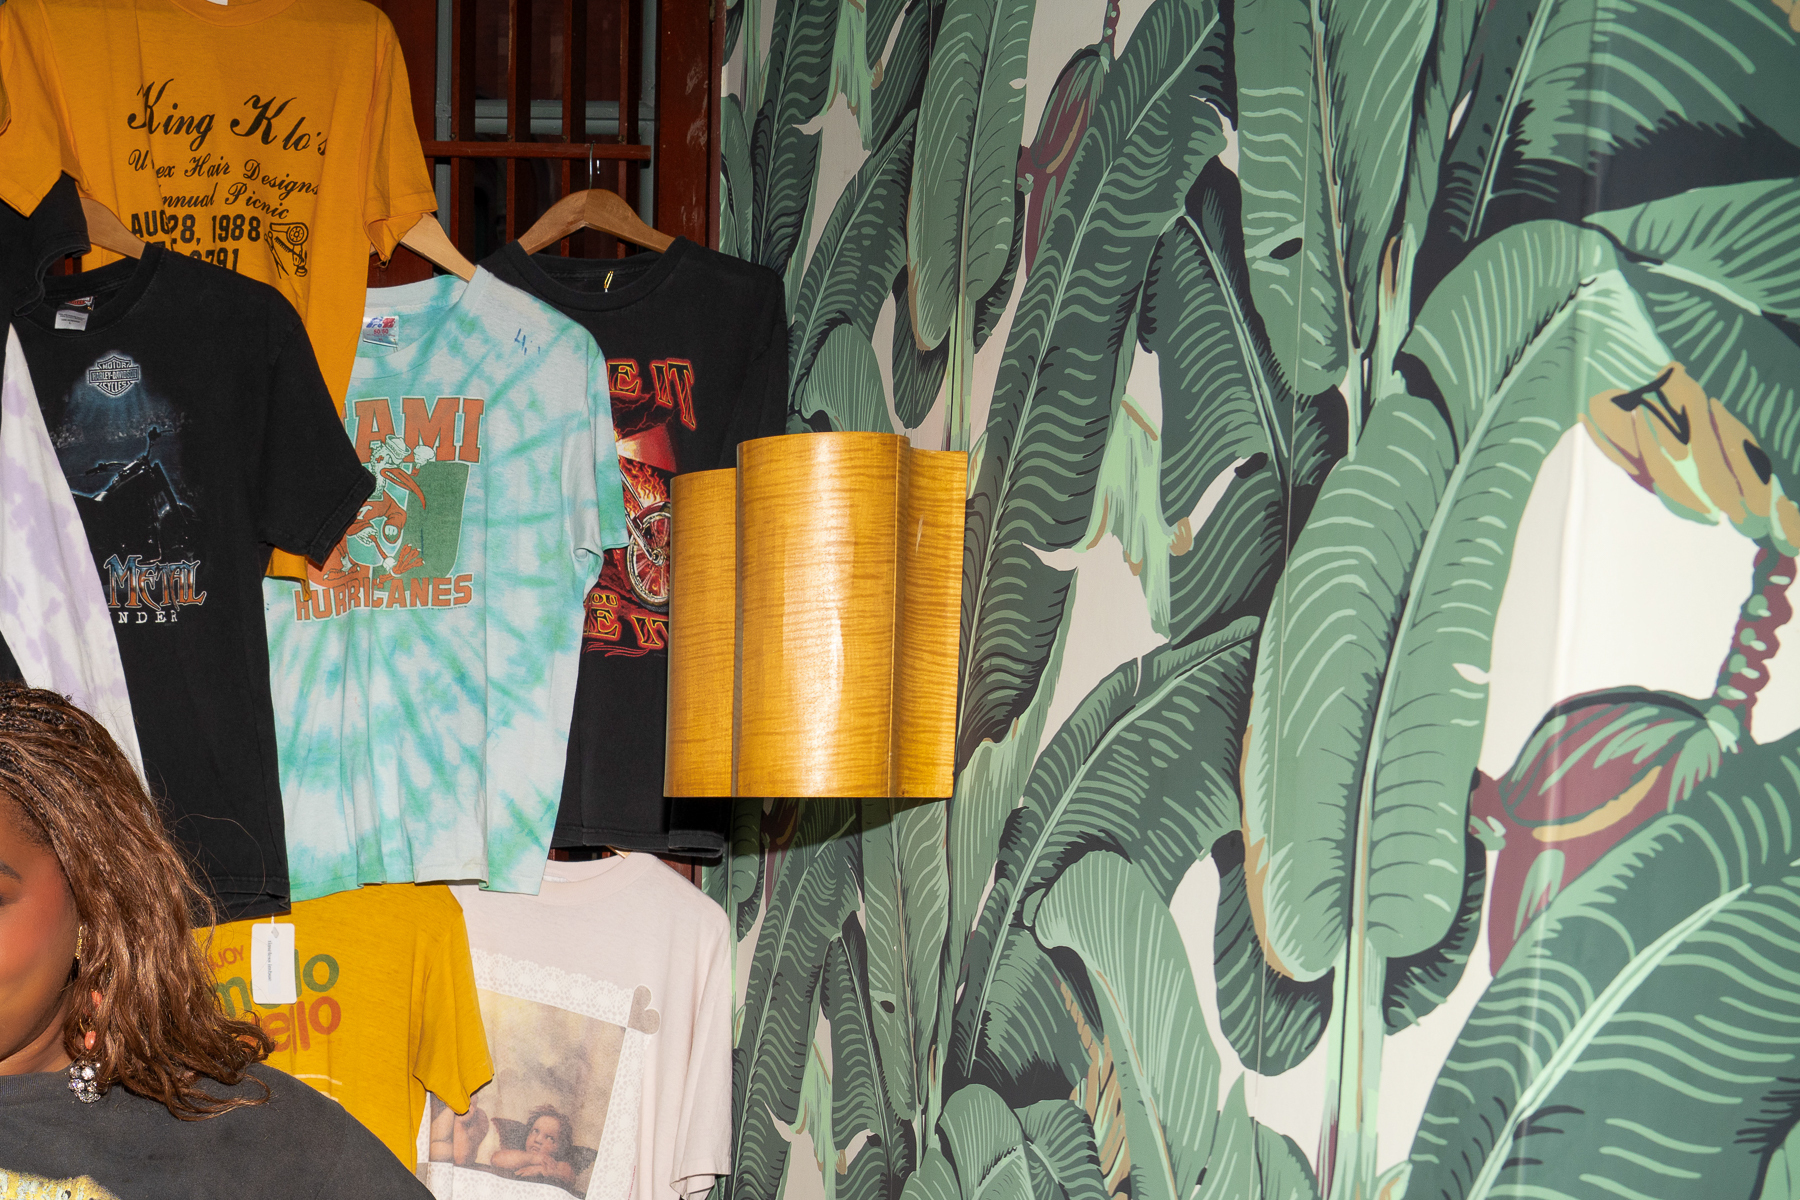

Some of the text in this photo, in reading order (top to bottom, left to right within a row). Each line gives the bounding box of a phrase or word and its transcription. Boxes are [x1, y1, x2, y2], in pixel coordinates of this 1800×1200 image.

[127, 78, 216, 152] King
[160, 182, 290, 219] nnual Picnic
[183, 153, 231, 179] Hair
[242, 158, 319, 200] Designs
[211, 213, 262, 244] 1988
[344, 396, 486, 465] AMI
[103, 553, 208, 612] METAL
[292, 571, 474, 623] HURRICANES
[109, 609, 179, 624] NDER
